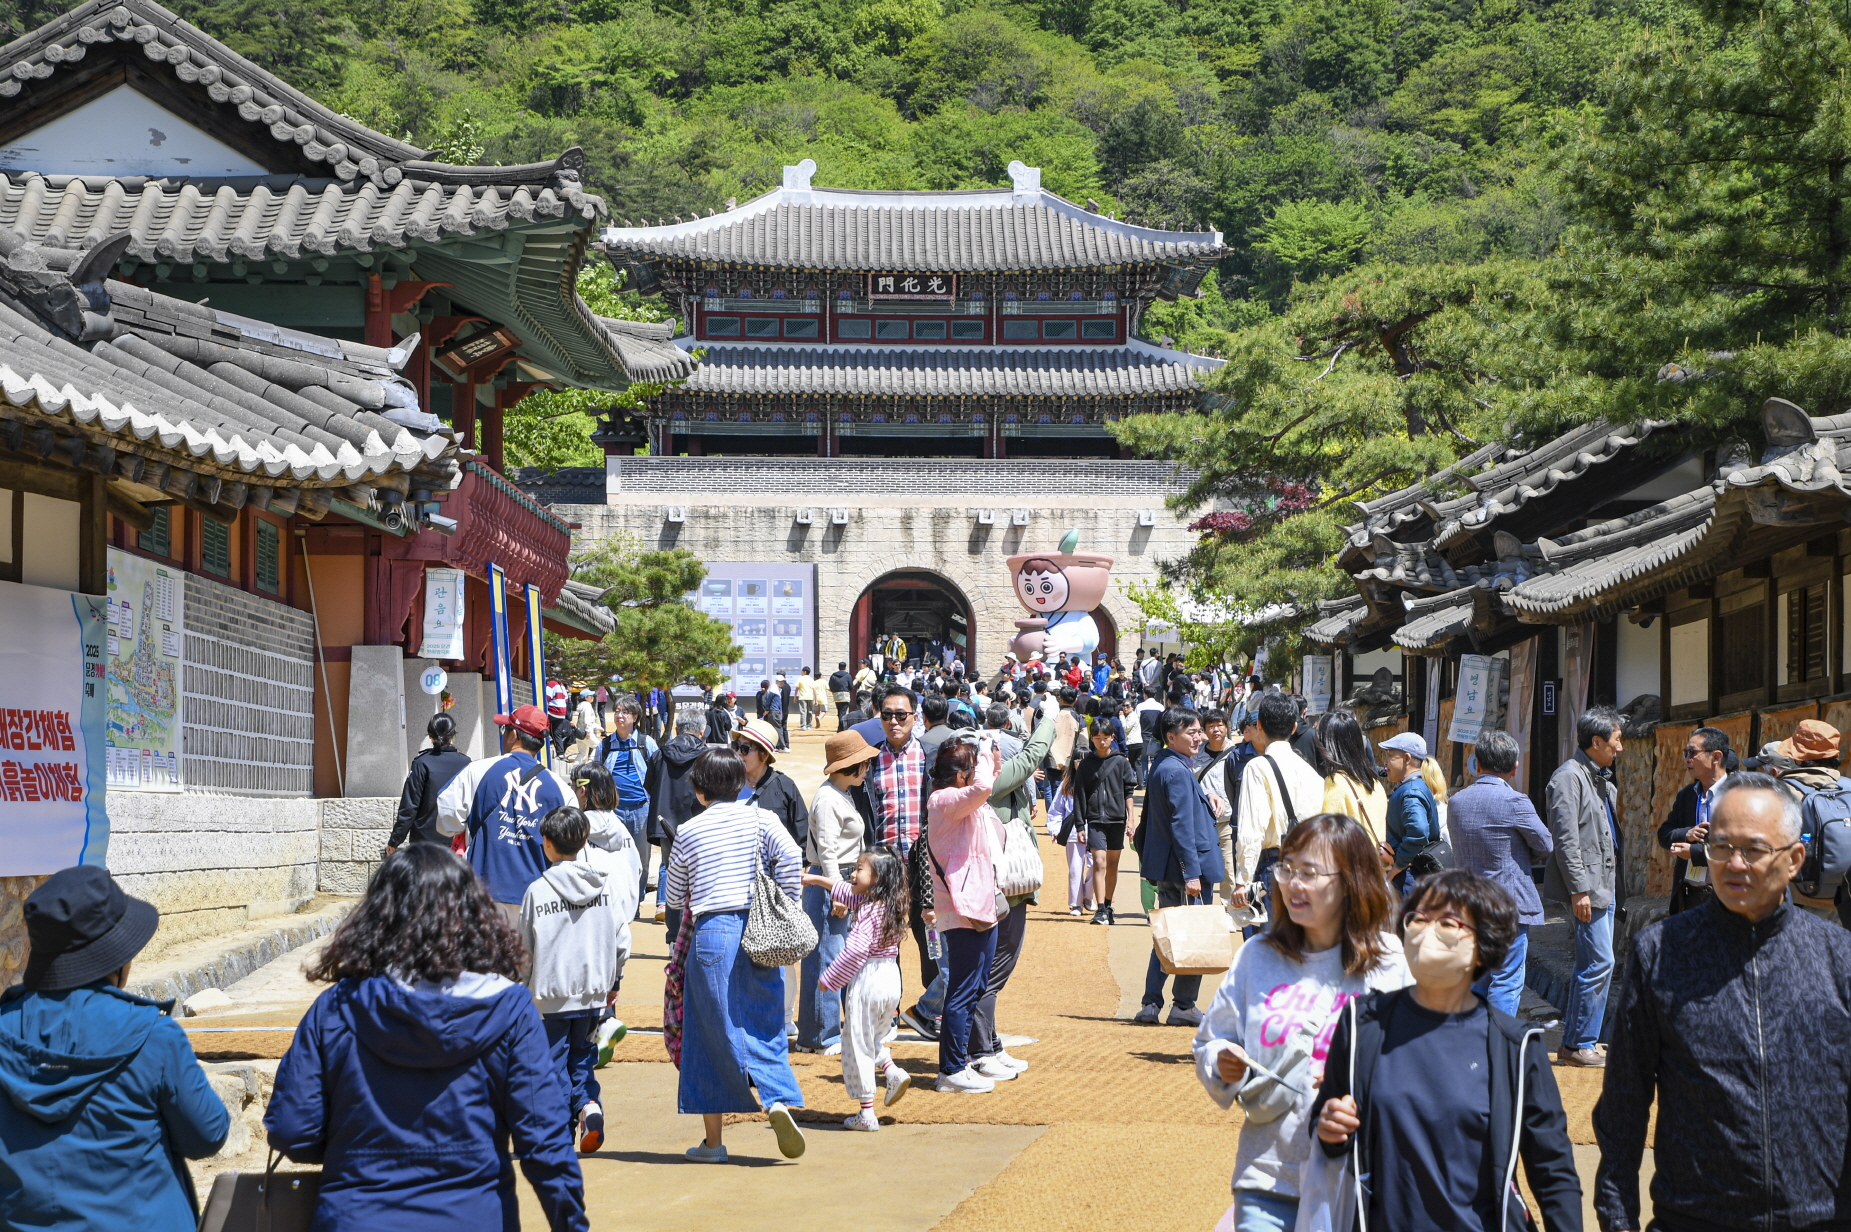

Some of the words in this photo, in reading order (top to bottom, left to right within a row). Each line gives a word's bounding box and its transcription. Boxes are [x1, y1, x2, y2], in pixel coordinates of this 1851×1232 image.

[85, 644, 99, 658] 2025
[426, 674, 441, 687] 08
[498, 810, 516, 823] New
[515, 815, 539, 828] York
[535, 894, 609, 918] PARAMUNT
